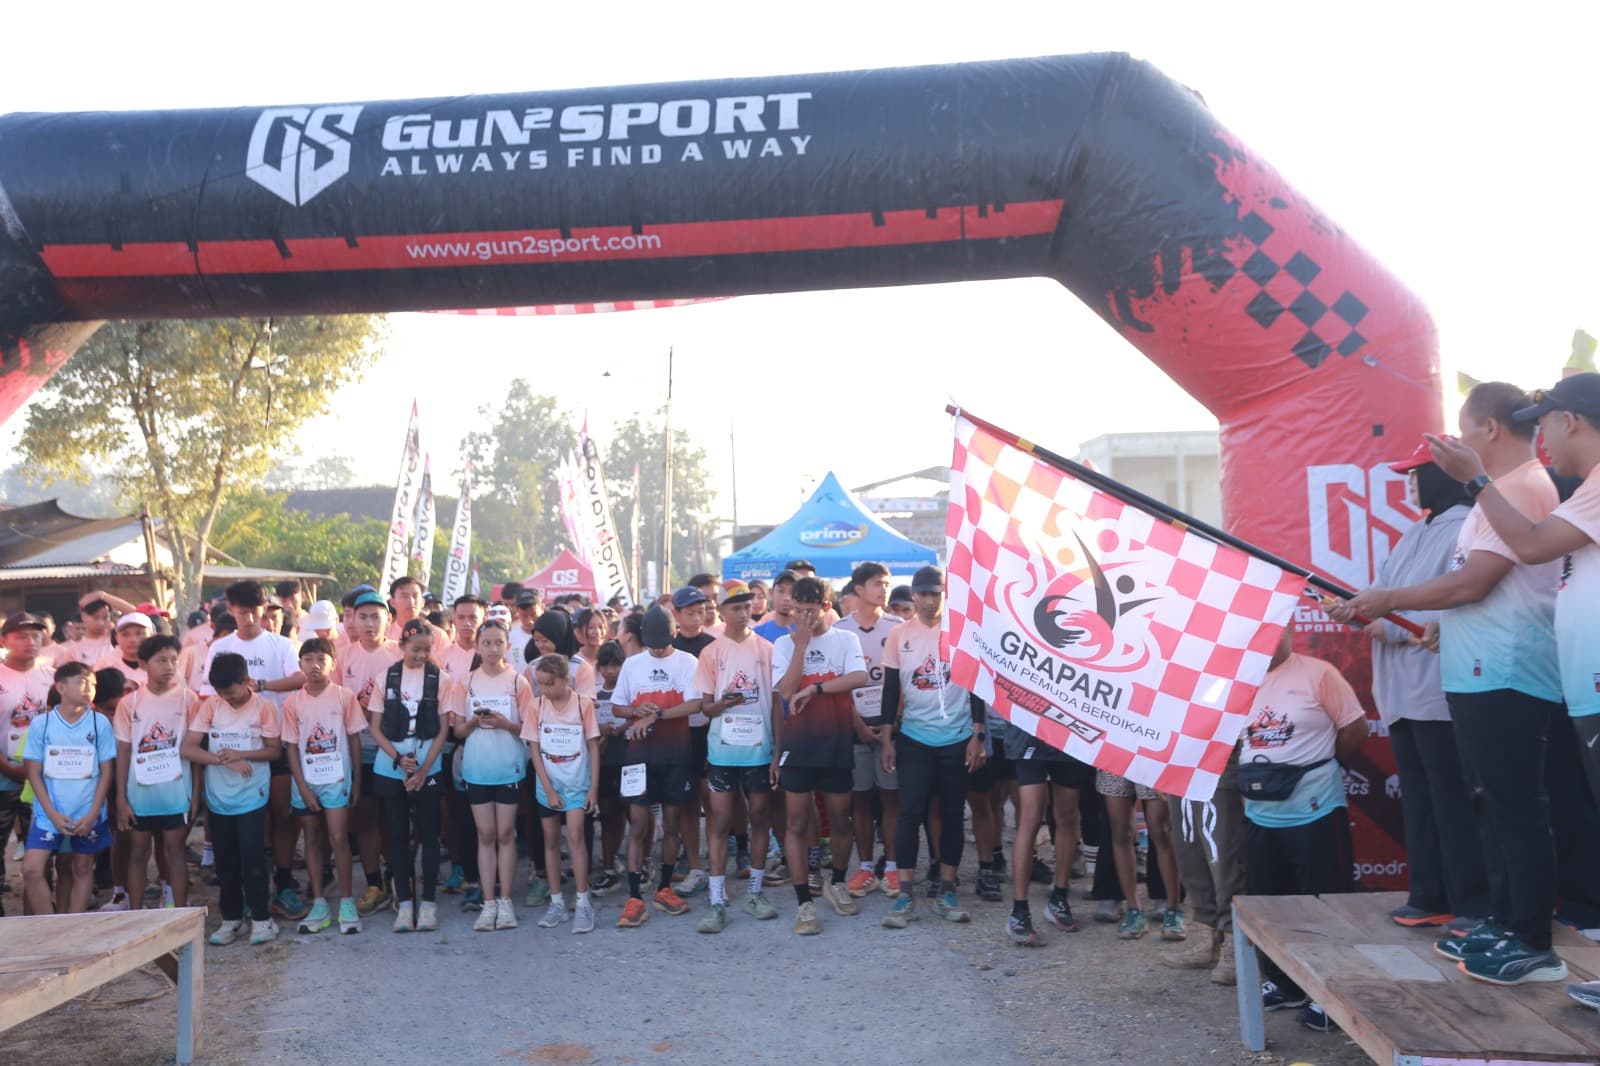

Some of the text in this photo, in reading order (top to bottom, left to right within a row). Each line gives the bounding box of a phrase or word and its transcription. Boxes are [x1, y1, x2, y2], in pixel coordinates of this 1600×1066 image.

[381, 135, 812, 177] ALWAYS FIND A WAY
[406, 231, 662, 260] www.gun2sport.com
[801, 527, 862, 542] prima
[1294, 623, 1344, 632] SPORT
[1000, 631, 1123, 710] GRAPARI
[973, 631, 1161, 741] GERAKAN PEMUDA BERDIKARI
[1353, 860, 1407, 880] goodr
